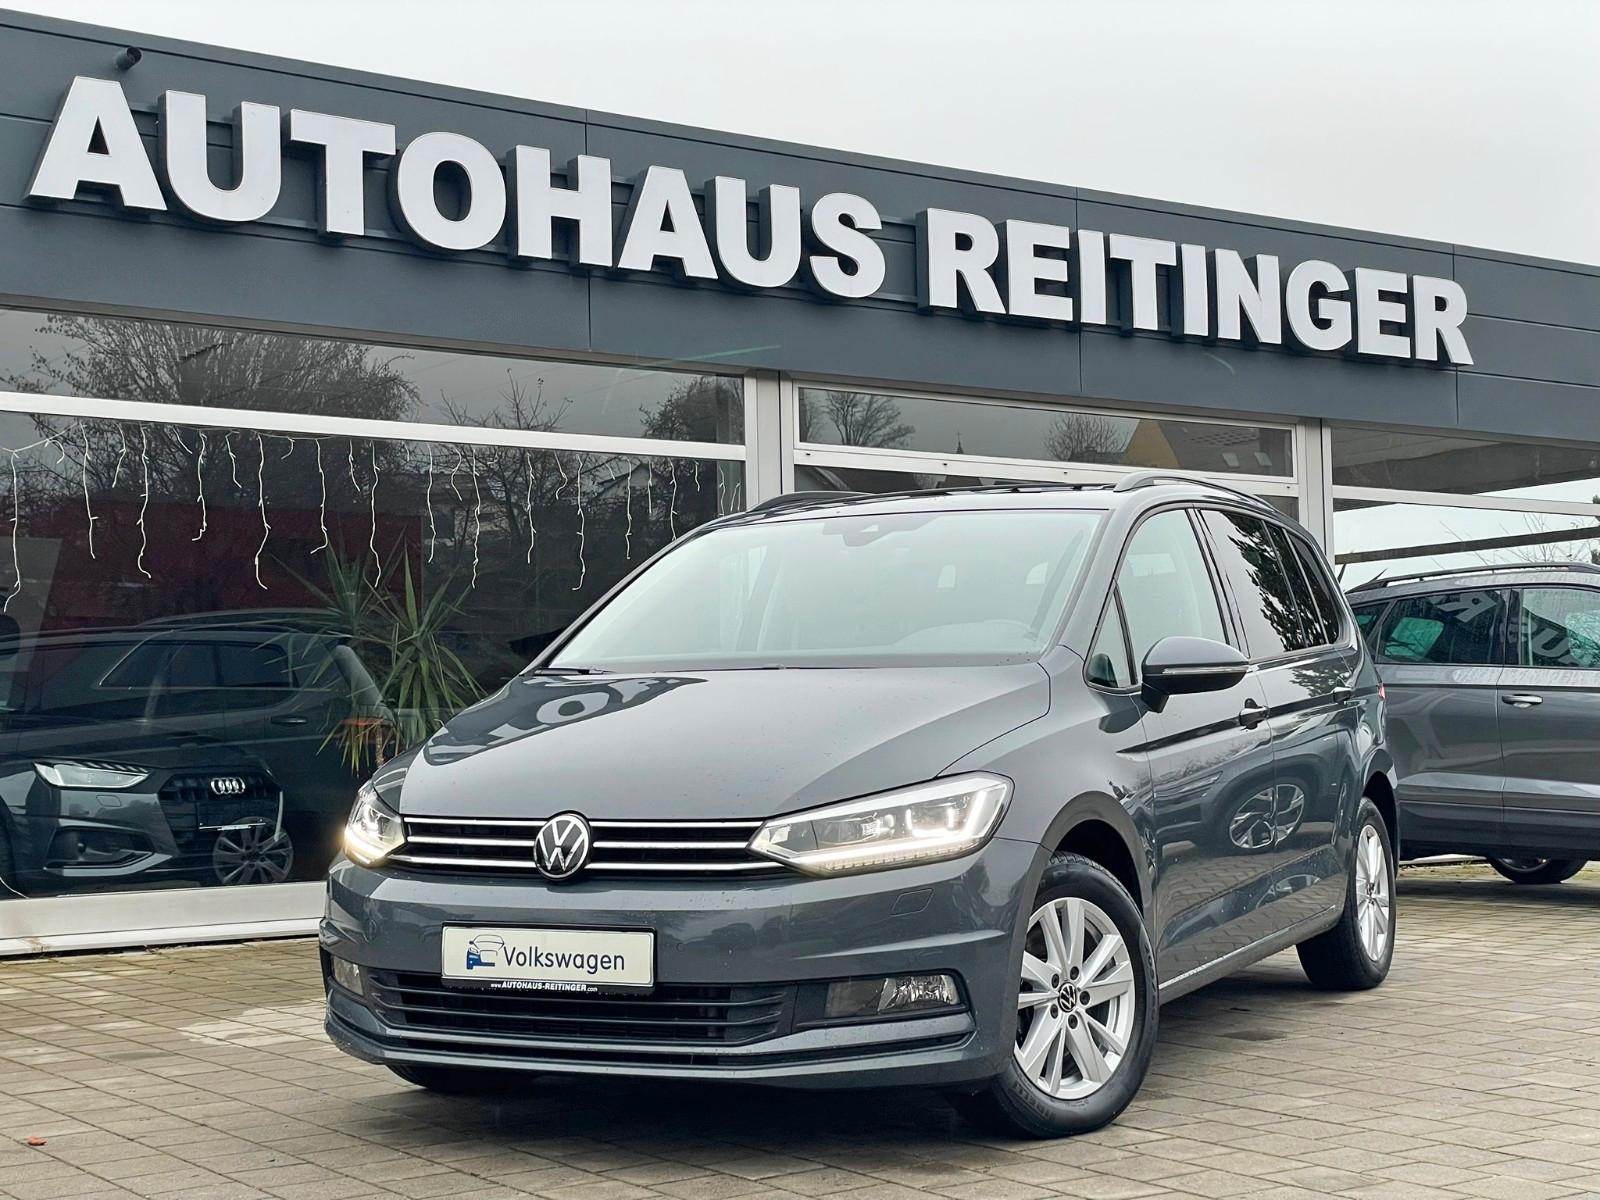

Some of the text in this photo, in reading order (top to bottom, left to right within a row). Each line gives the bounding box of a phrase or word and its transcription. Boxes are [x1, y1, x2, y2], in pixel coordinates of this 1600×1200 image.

[28, 75, 1474, 366] AUTOHAUS REITINGER
[503, 945, 625, 974] Volkswagen
